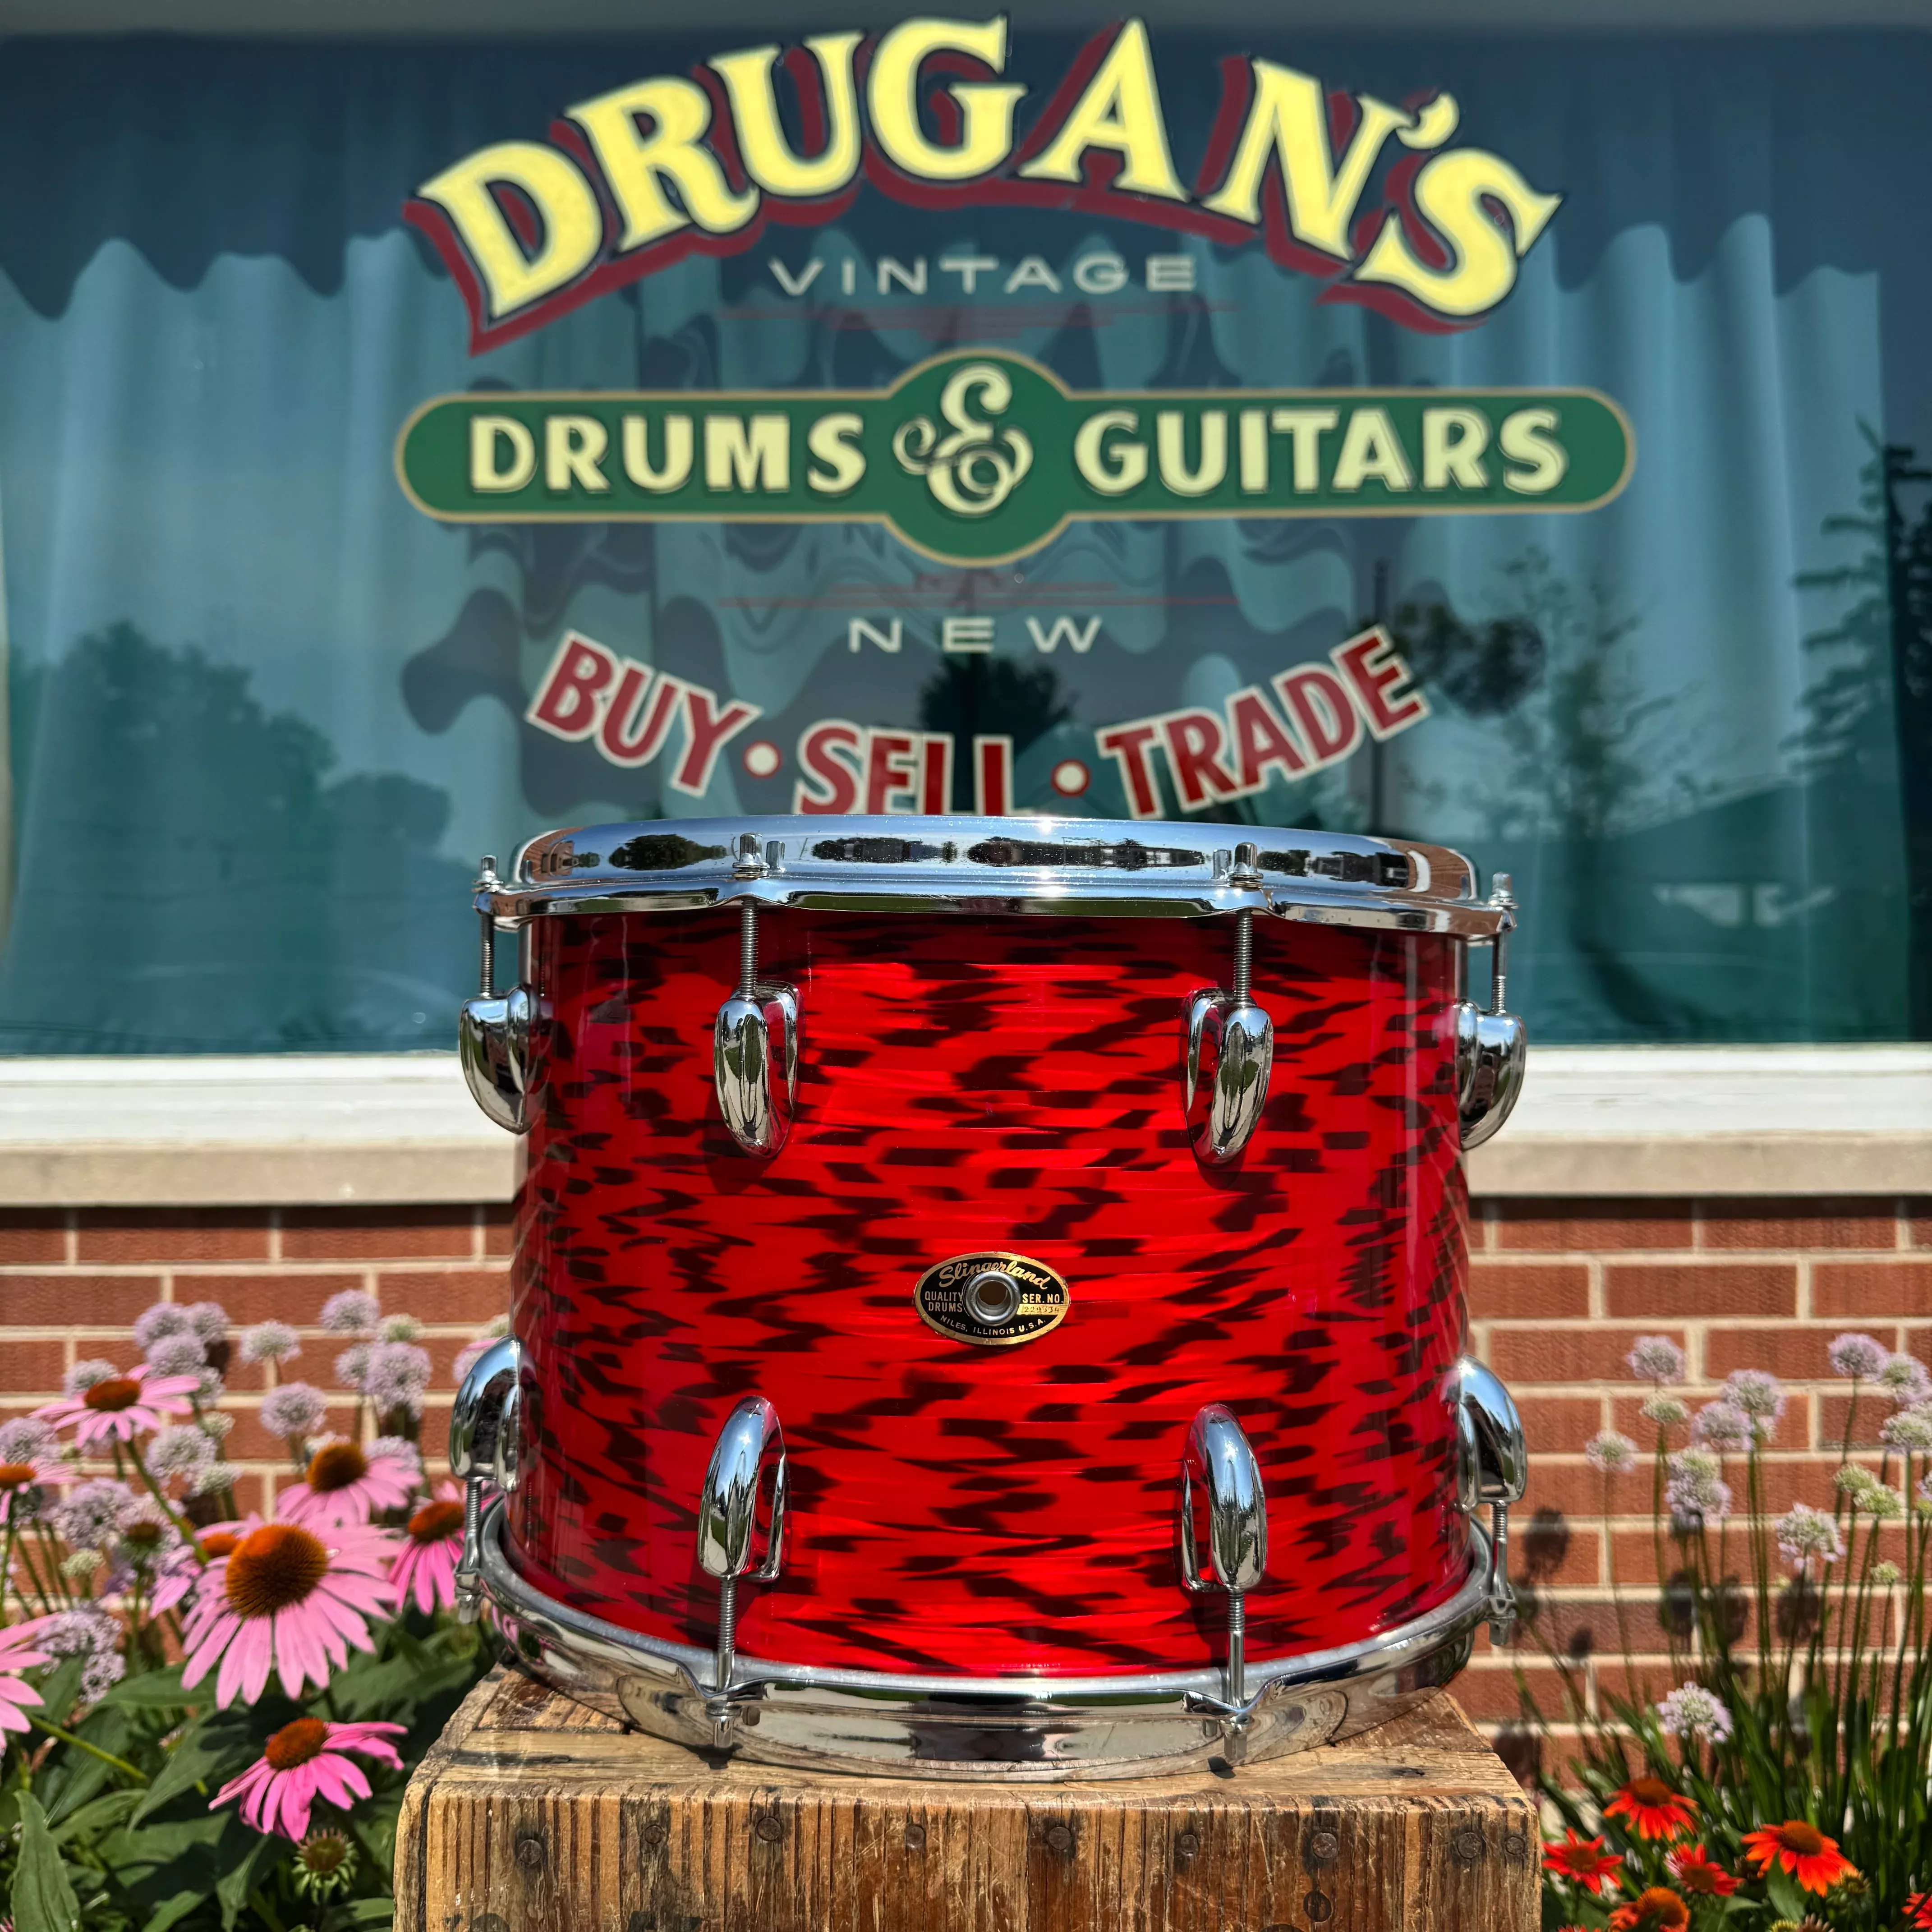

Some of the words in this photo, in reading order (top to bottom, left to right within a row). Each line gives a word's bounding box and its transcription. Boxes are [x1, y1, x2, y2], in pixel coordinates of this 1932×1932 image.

[414, 16, 1565, 323] DRUGAN'S
[768, 255, 1196, 295] VINTAGE
[469, 414, 866, 495] DRUMS
[893, 364, 1033, 515] &
[1073, 408, 1568, 496] GUITARS
[848, 616, 1102, 653] NEW
[525, 630, 763, 798] BUY
[1095, 625, 1431, 820] TRADE
[938, 1260, 1051, 1289] Slingerland
[925, 1291, 963, 1302] QUALITY
[929, 1302, 962, 1312] DRUMS
[1022, 1293, 1045, 1303] SER.
[1047, 1293, 1063, 1303] NO.
[940, 1315, 967, 1332] NILES,
[973, 1327, 1015, 1335] ILLINOIS
[1018, 1318, 1046, 1333] U.S.A.
